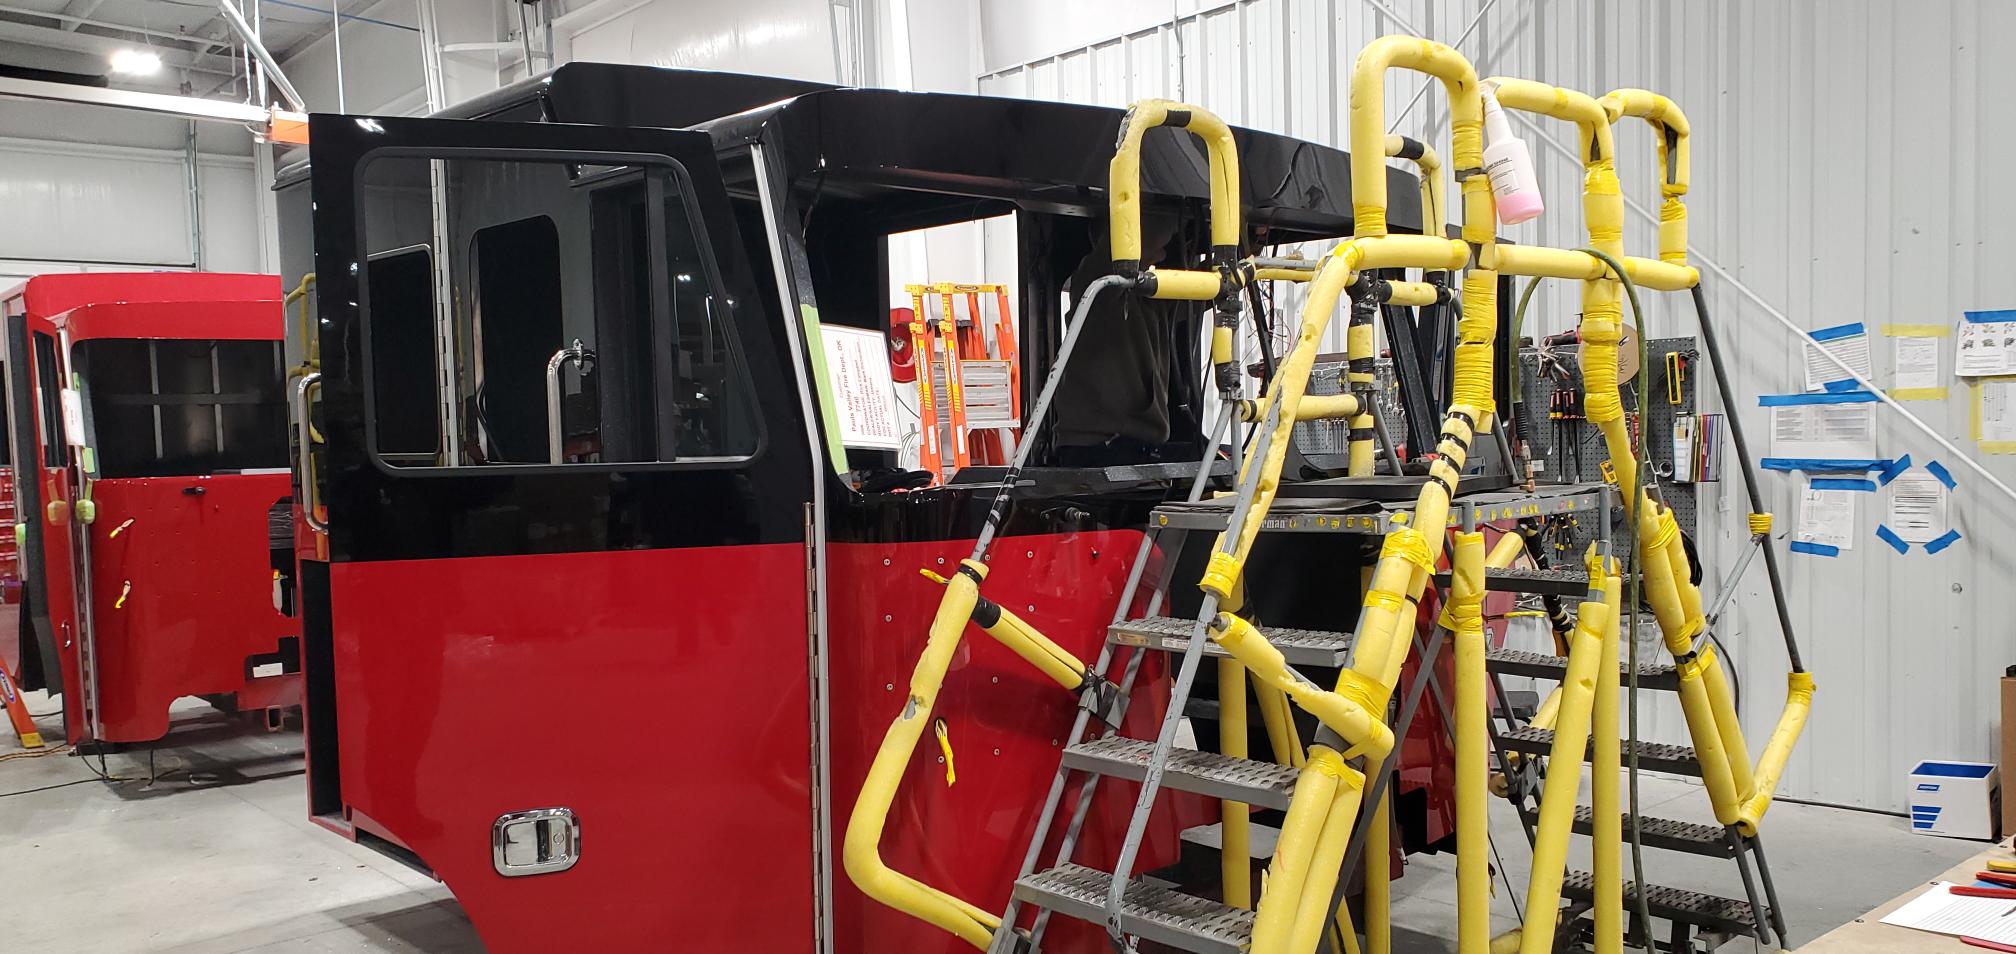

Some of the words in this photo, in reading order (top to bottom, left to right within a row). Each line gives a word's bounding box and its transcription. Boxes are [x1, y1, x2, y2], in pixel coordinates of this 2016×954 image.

[842, 374, 850, 388] Fire
[845, 390, 855, 411] Valley
[849, 412, 858, 432] Pauls
